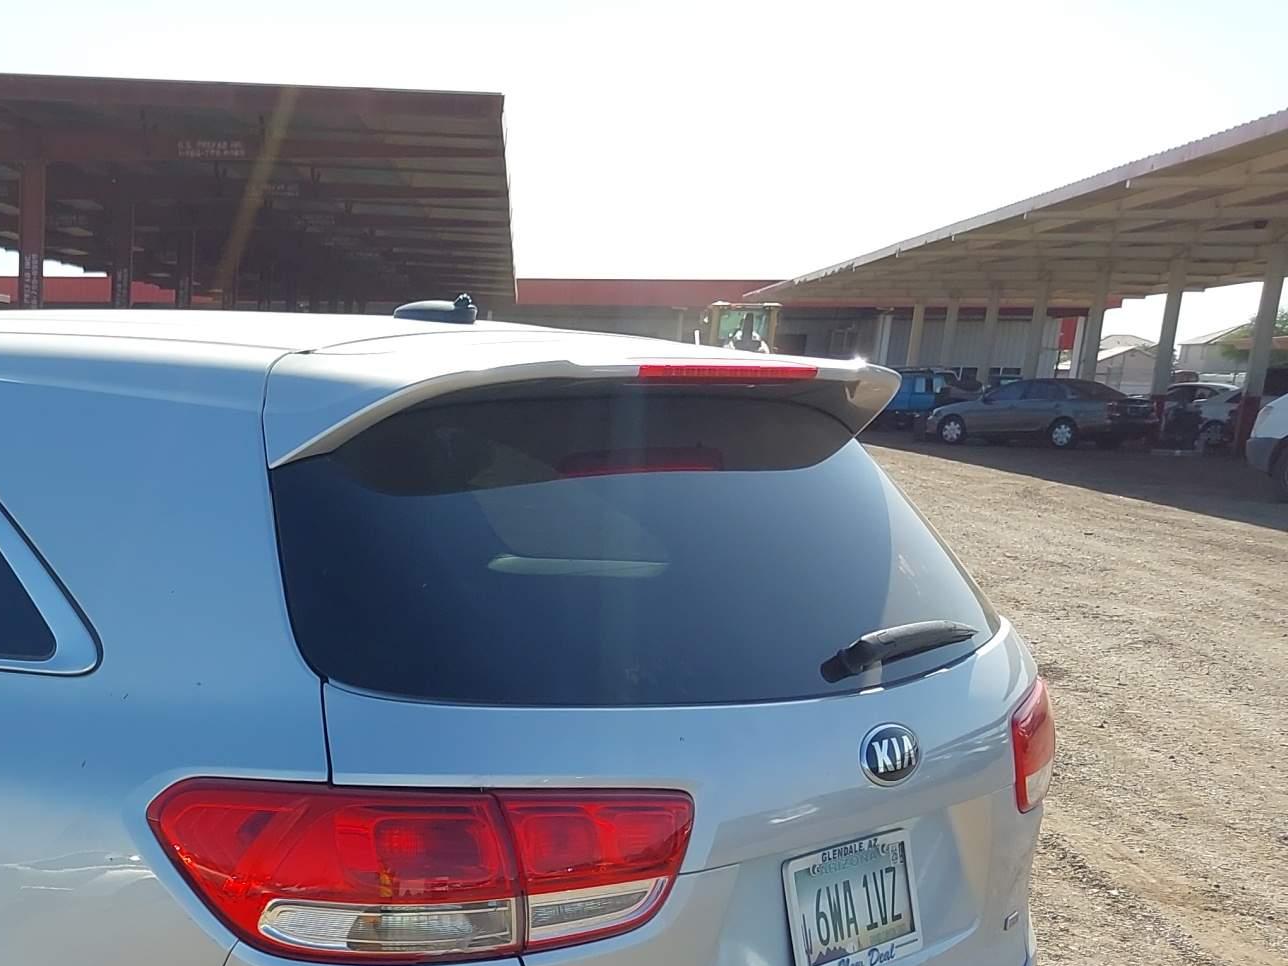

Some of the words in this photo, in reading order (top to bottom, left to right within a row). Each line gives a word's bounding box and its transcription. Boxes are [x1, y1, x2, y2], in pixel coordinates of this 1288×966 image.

[871, 735, 916, 773] KIA
[815, 879, 859, 946] 6WA
[862, 866, 902, 931] 1VZ
[867, 943, 896, 966] Deal
